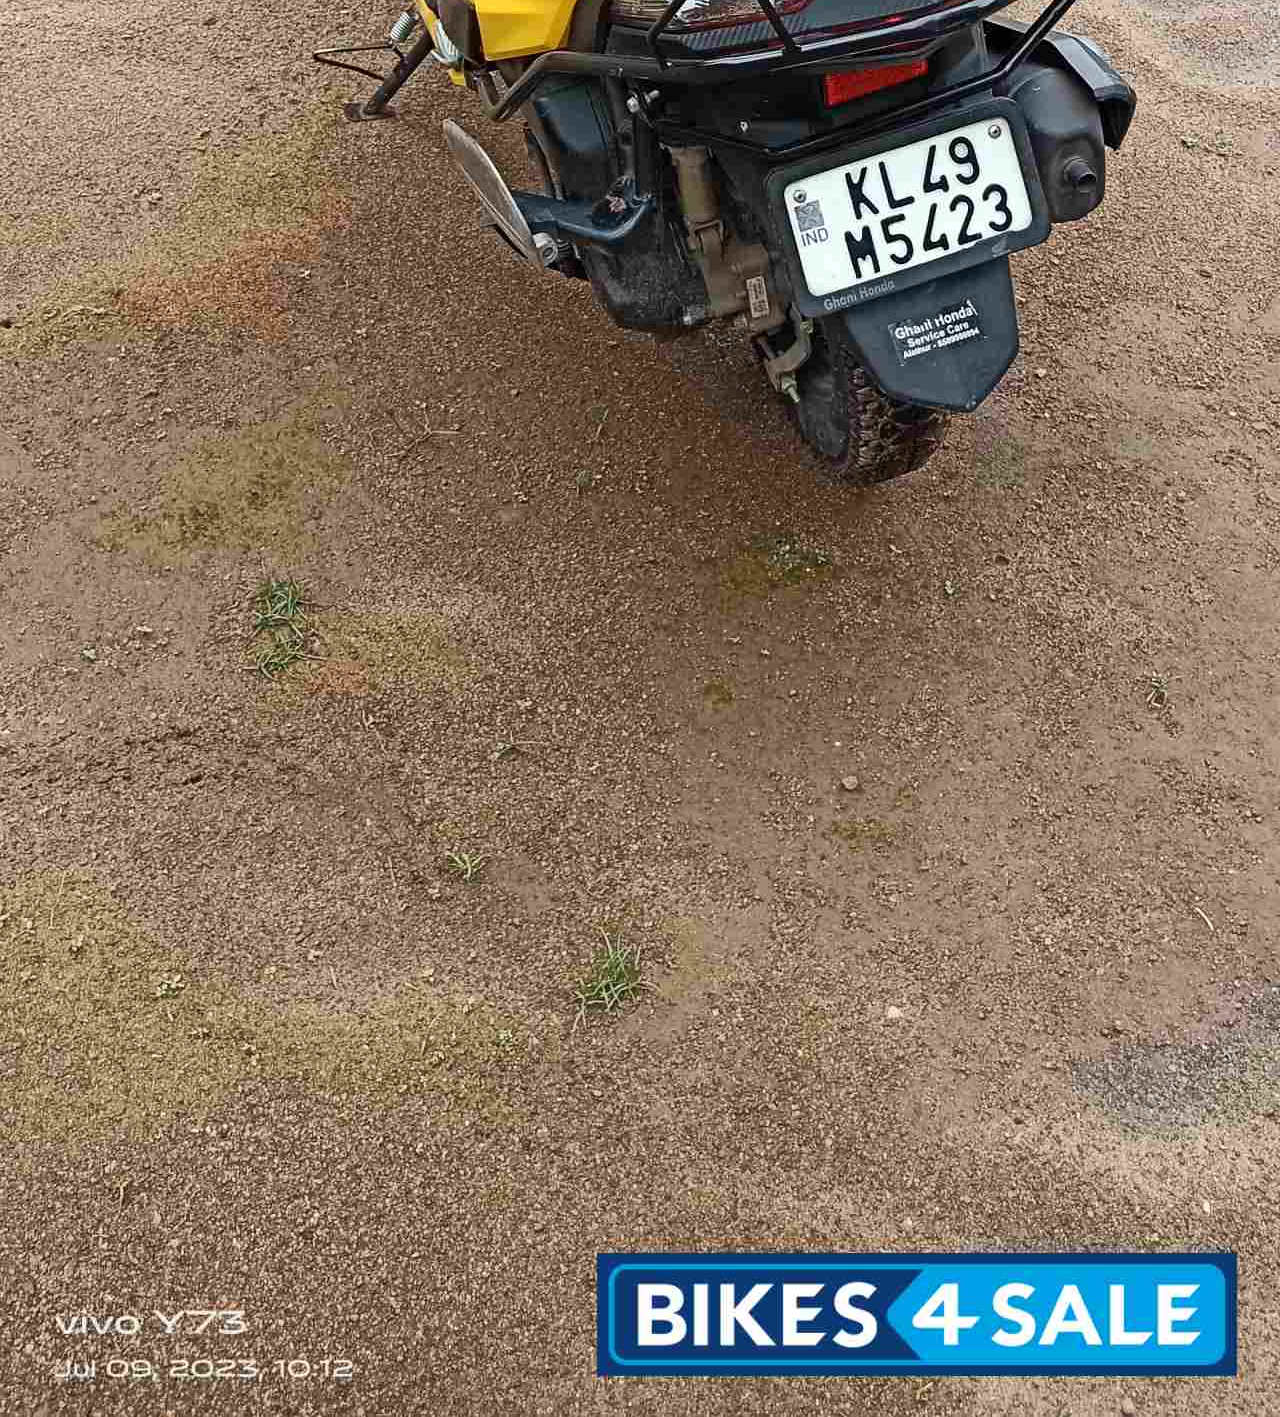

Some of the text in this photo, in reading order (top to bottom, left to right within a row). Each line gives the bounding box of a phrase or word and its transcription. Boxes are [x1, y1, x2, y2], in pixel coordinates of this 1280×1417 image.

[845, 136, 981, 220] KL 49
[801, 228, 829, 247] IND
[844, 183, 1013, 279] M5423
[858, 278, 896, 300] Honda
[933, 304, 974, 327] Honda
[906, 331, 946, 348] Service
[946, 322, 969, 335] Care
